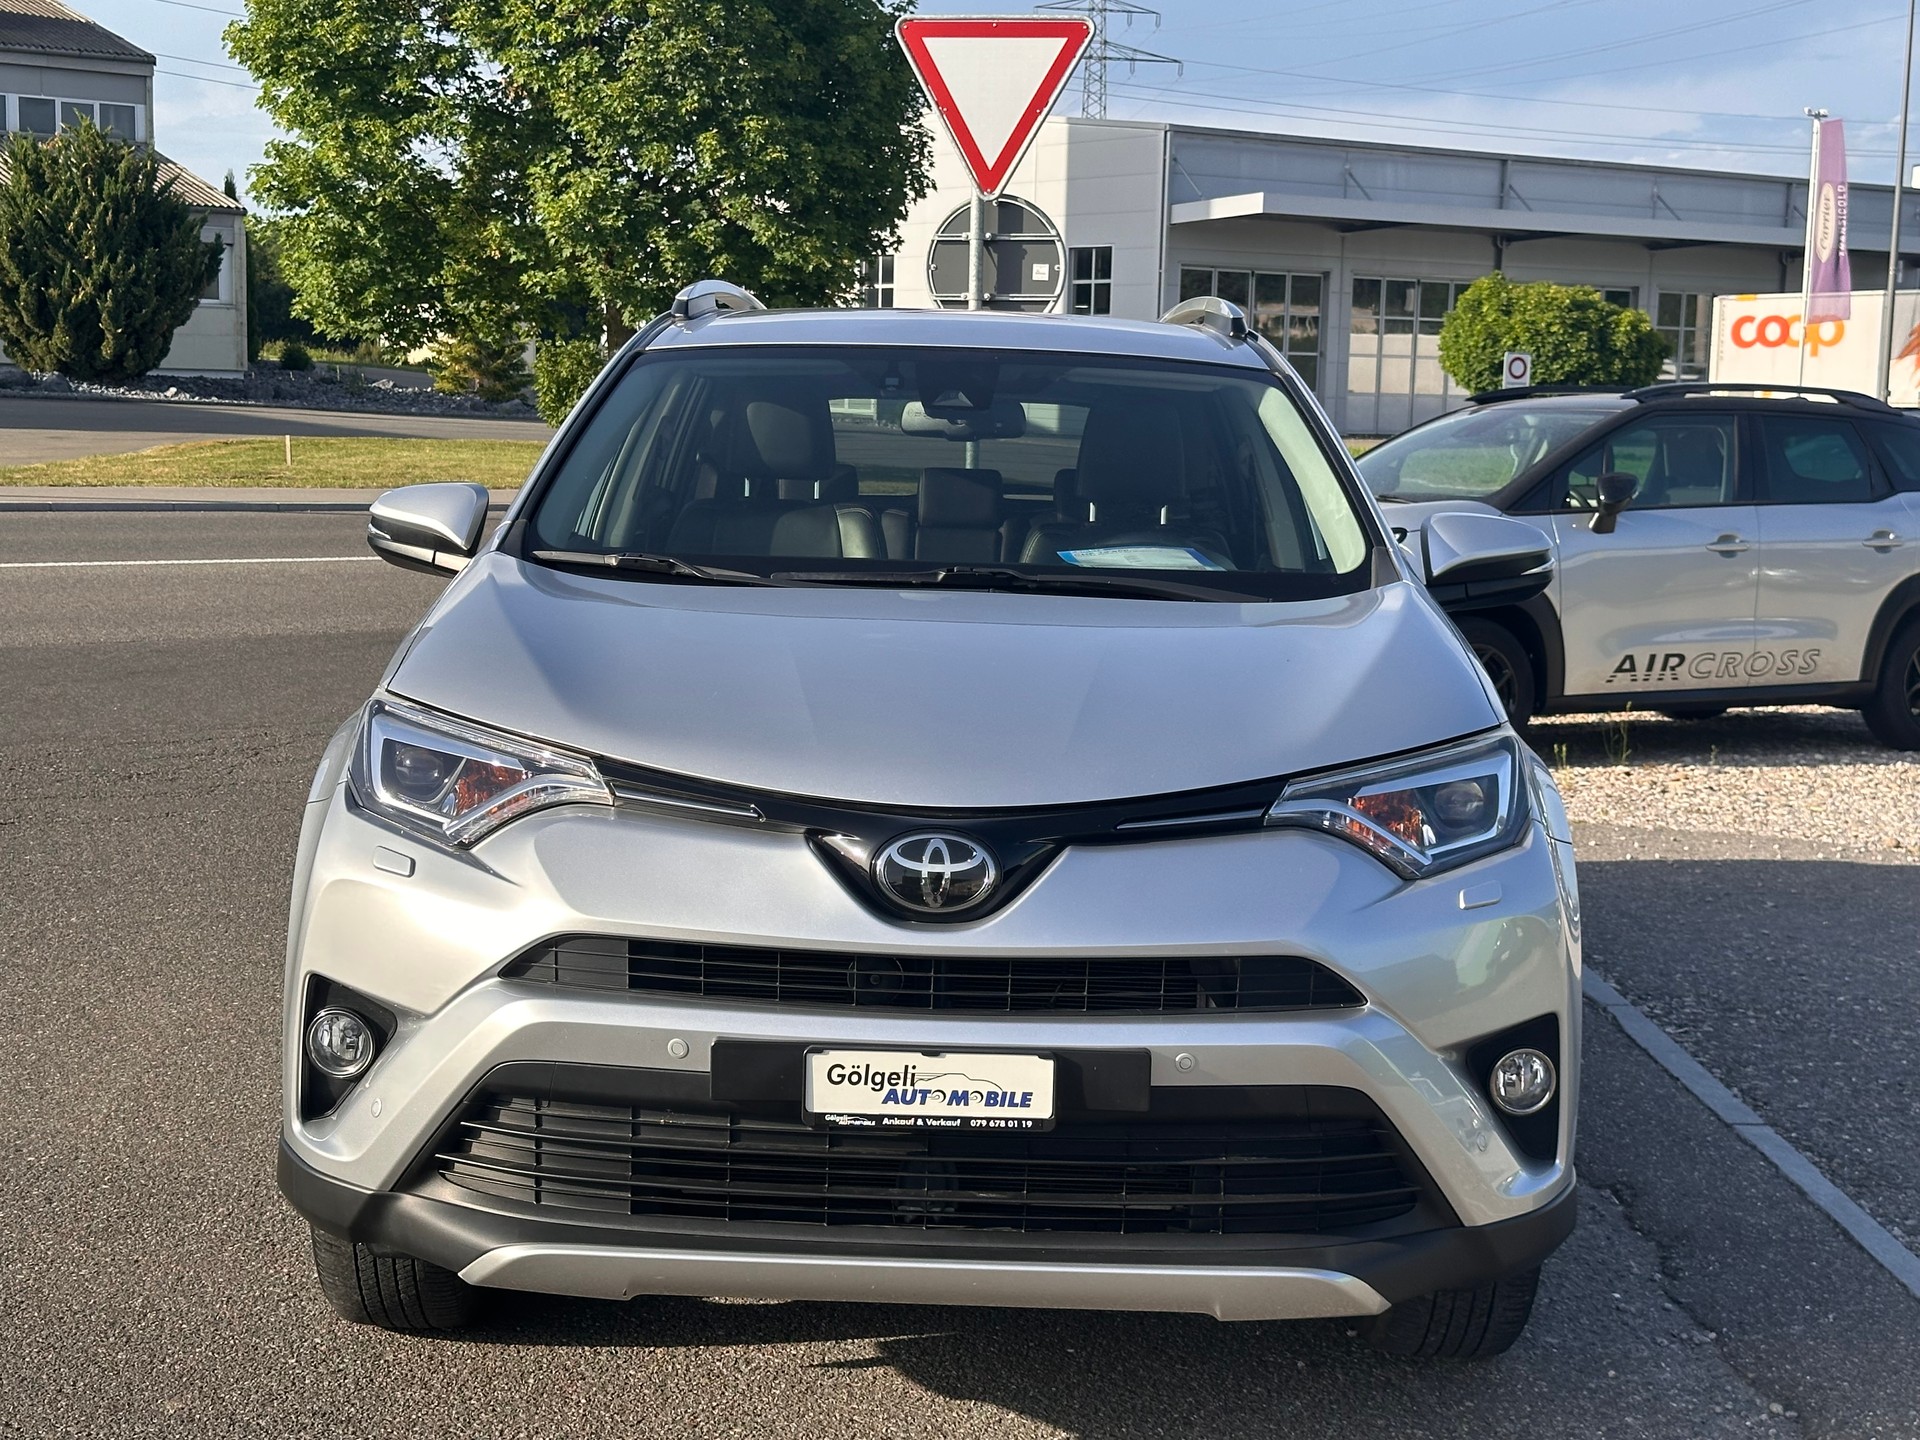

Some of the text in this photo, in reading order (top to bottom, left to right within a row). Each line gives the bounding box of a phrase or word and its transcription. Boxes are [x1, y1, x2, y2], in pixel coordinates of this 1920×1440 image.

[1819, 193, 1831, 250] Carrier
[1731, 314, 1845, 358] coop
[1605, 649, 1820, 684] AIRCROSS
[826, 1063, 917, 1092] Gölgeli
[882, 1117, 1033, 1128] Ankauf & Verkauf 079 678 01 19
